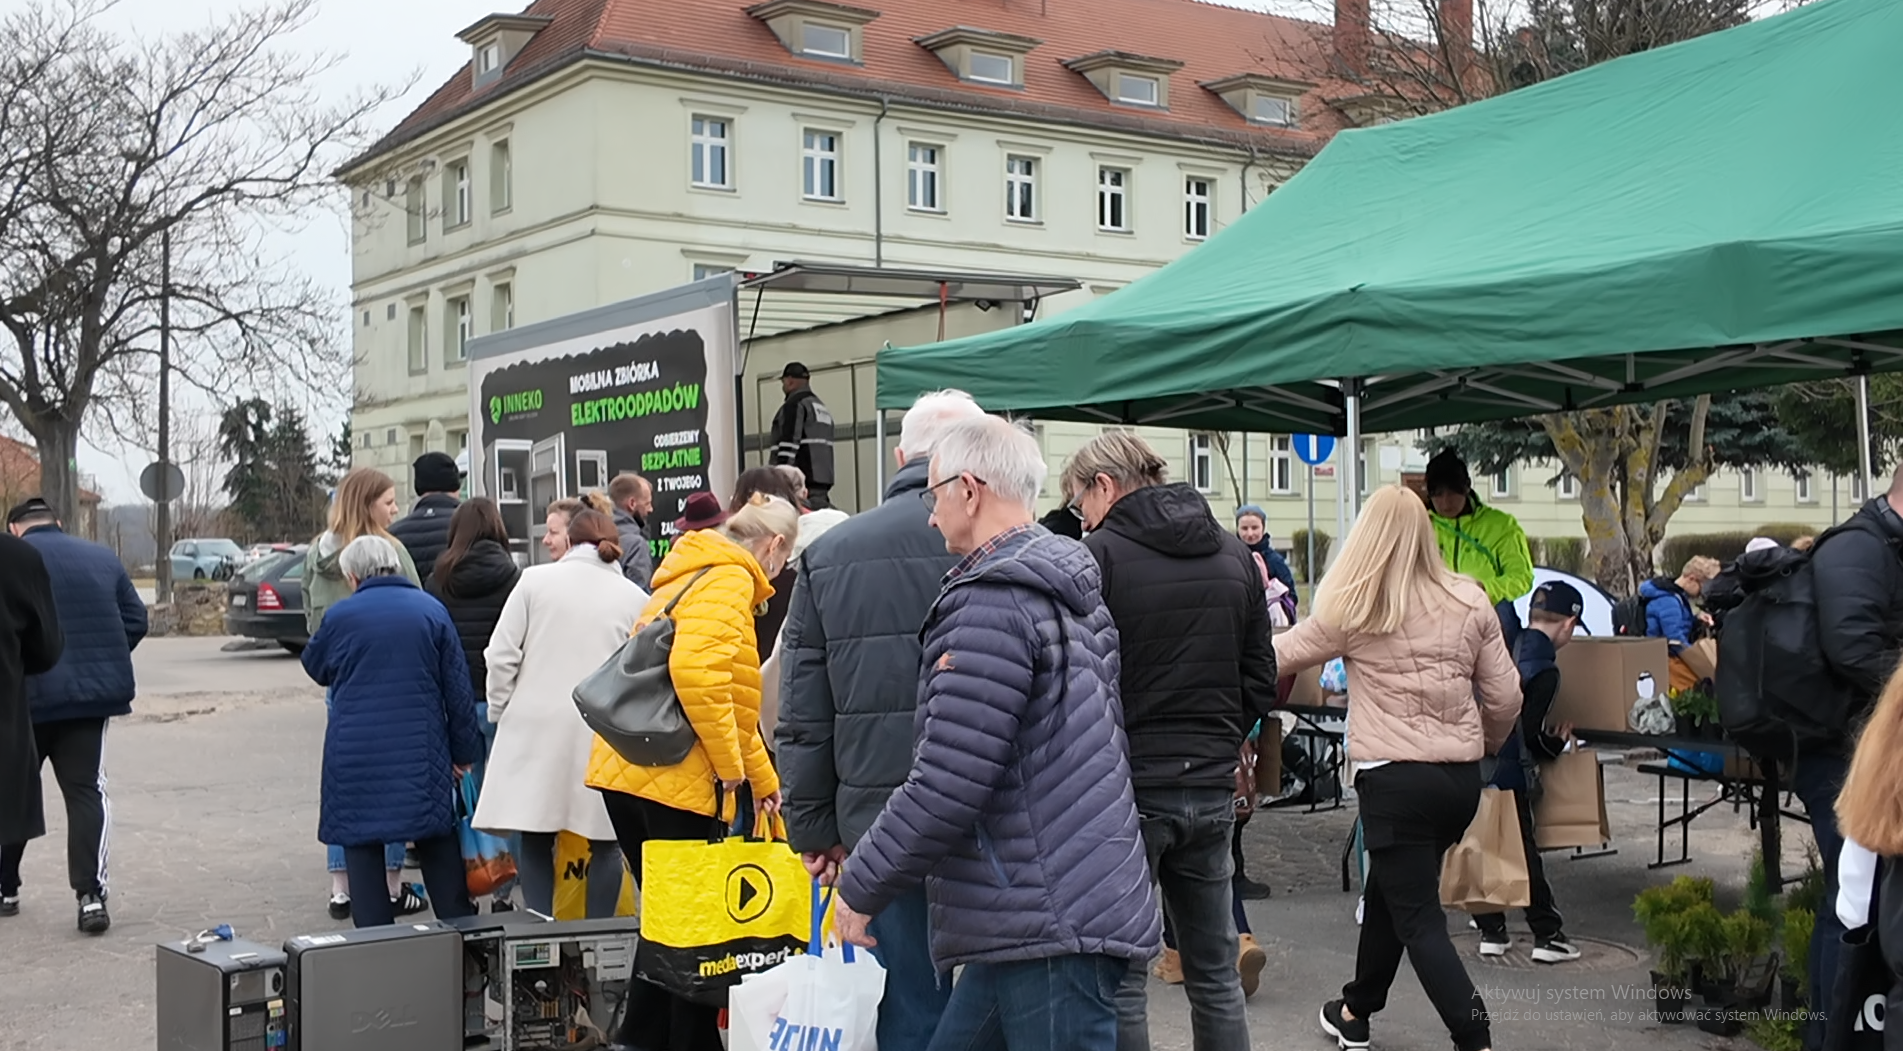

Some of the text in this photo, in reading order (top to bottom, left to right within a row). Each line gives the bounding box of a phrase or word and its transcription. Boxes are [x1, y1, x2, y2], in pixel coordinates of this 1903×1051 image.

[569, 361, 660, 394] MOBILNA ZBIÓRKA
[503, 389, 542, 414] INNEKO
[571, 381, 699, 427] ELEKTROODPADÓW
[653, 430, 700, 448] ODBIERZEMY
[641, 447, 702, 471] BEZPŁATNIE
[657, 474, 702, 492] Z TWOJEGO
[351, 1004, 418, 1034] DELL
